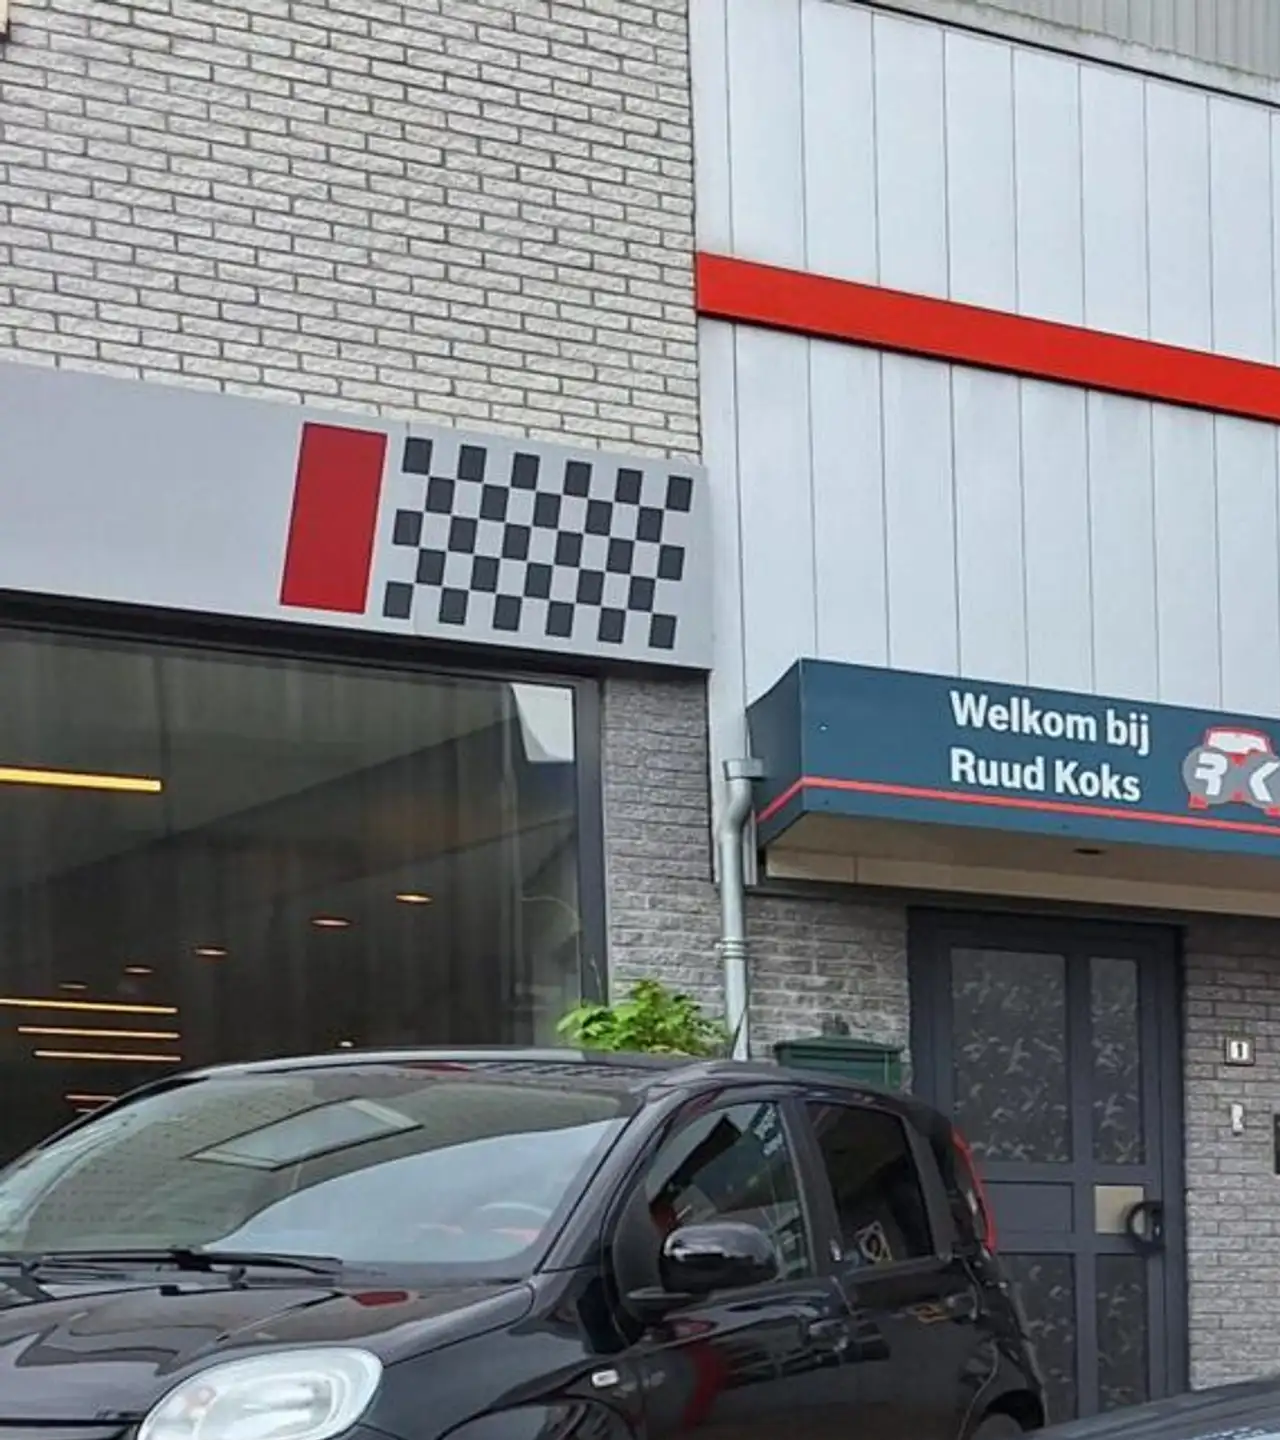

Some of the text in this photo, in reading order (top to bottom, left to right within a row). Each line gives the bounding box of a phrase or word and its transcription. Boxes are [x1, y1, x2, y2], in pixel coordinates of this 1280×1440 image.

[950, 690, 1150, 755] Welkom bij
[950, 748, 1141, 802] Ruud Koks
